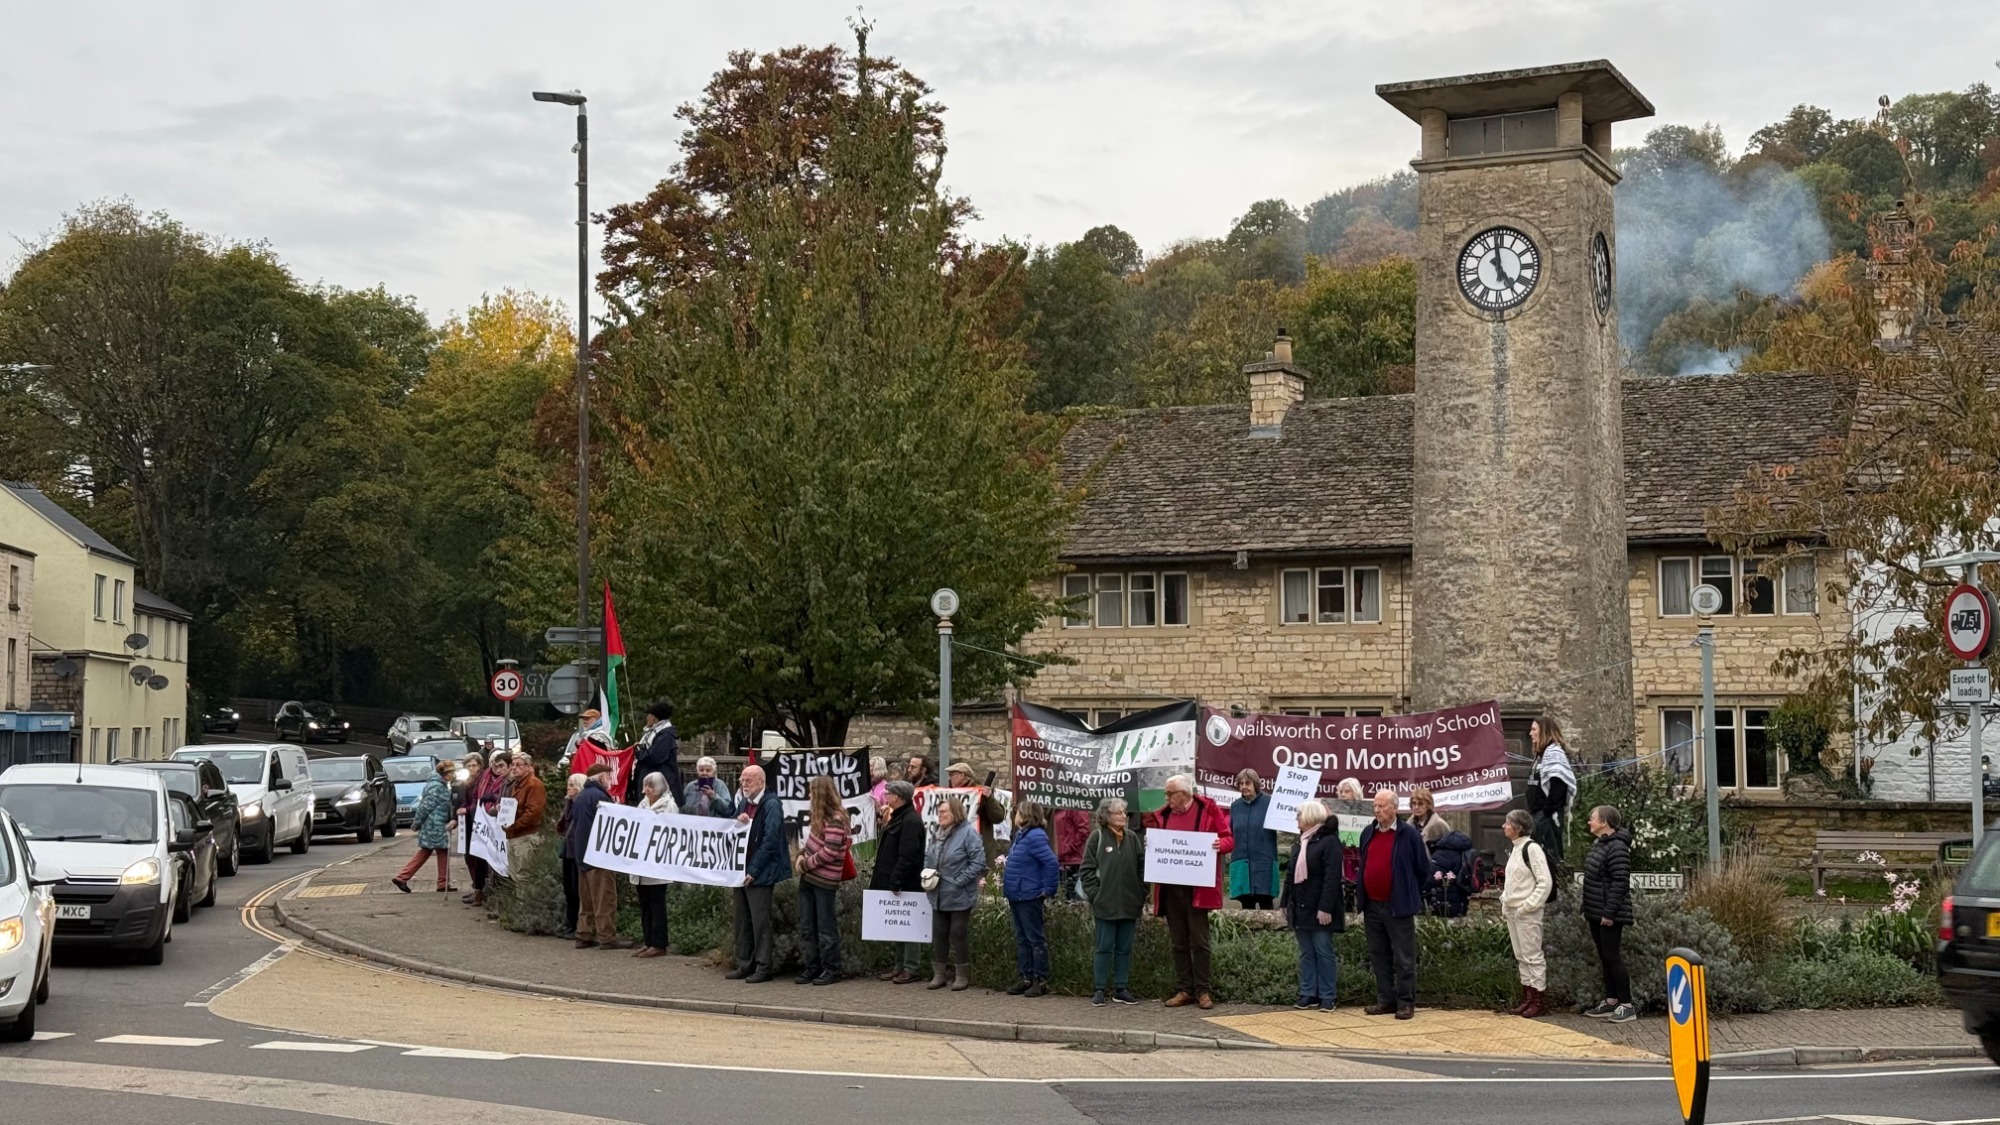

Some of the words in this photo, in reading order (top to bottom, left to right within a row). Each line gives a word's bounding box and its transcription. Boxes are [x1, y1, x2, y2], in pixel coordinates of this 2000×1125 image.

[496, 677, 519, 691] 30
[1952, 674, 1975, 684] Except
[1977, 673, 1987, 684] for
[523, 684, 543, 697] MI
[1957, 686, 1982, 698] loading
[1235, 720, 1321, 739] Nailsworth
[1325, 724, 1336, 739] C
[1340, 723, 1359, 740] of
[1363, 724, 1373, 740] E
[1377, 722, 1434, 740] Primary
[1436, 707, 1496, 733] School
[1016, 737, 1032, 747] NO
[1033, 739, 1045, 749] TO
[1047, 742, 1094, 758] ILLEGAL
[779, 752, 858, 776] STROUD
[1019, 750, 1083, 768] OCCUPATION
[1272, 745, 1338, 770] Open
[1345, 743, 1462, 770] Mornings
[1016, 765, 1037, 777] NO
[1039, 767, 1054, 780] TO
[1058, 770, 1132, 785] APARTHEID
[1286, 771, 1308, 782] Stop
[1399, 775, 1464, 793] November
[1467, 771, 1479, 783] at
[1481, 766, 1508, 780] 9am
[776, 772, 862, 798] DISICT
[1019, 781, 1037, 791] NO
[1040, 782, 1053, 793] TO
[1056, 784, 1125, 798] SUPPORTING
[1276, 786, 1309, 800] Arming
[1450, 793, 1460, 801] of
[1026, 794, 1051, 806] WAR
[1055, 796, 1094, 810] CRIMES
[1276, 802, 1298, 813] Israe
[595, 814, 640, 860] VIGIL
[644, 825, 678, 865] FOR
[675, 828, 747, 872] PALESTINE
[1154, 848, 1207, 857] HUMANITARIAN
[1632, 874, 1681, 888] STREET
[62, 906, 86, 917] MXC
